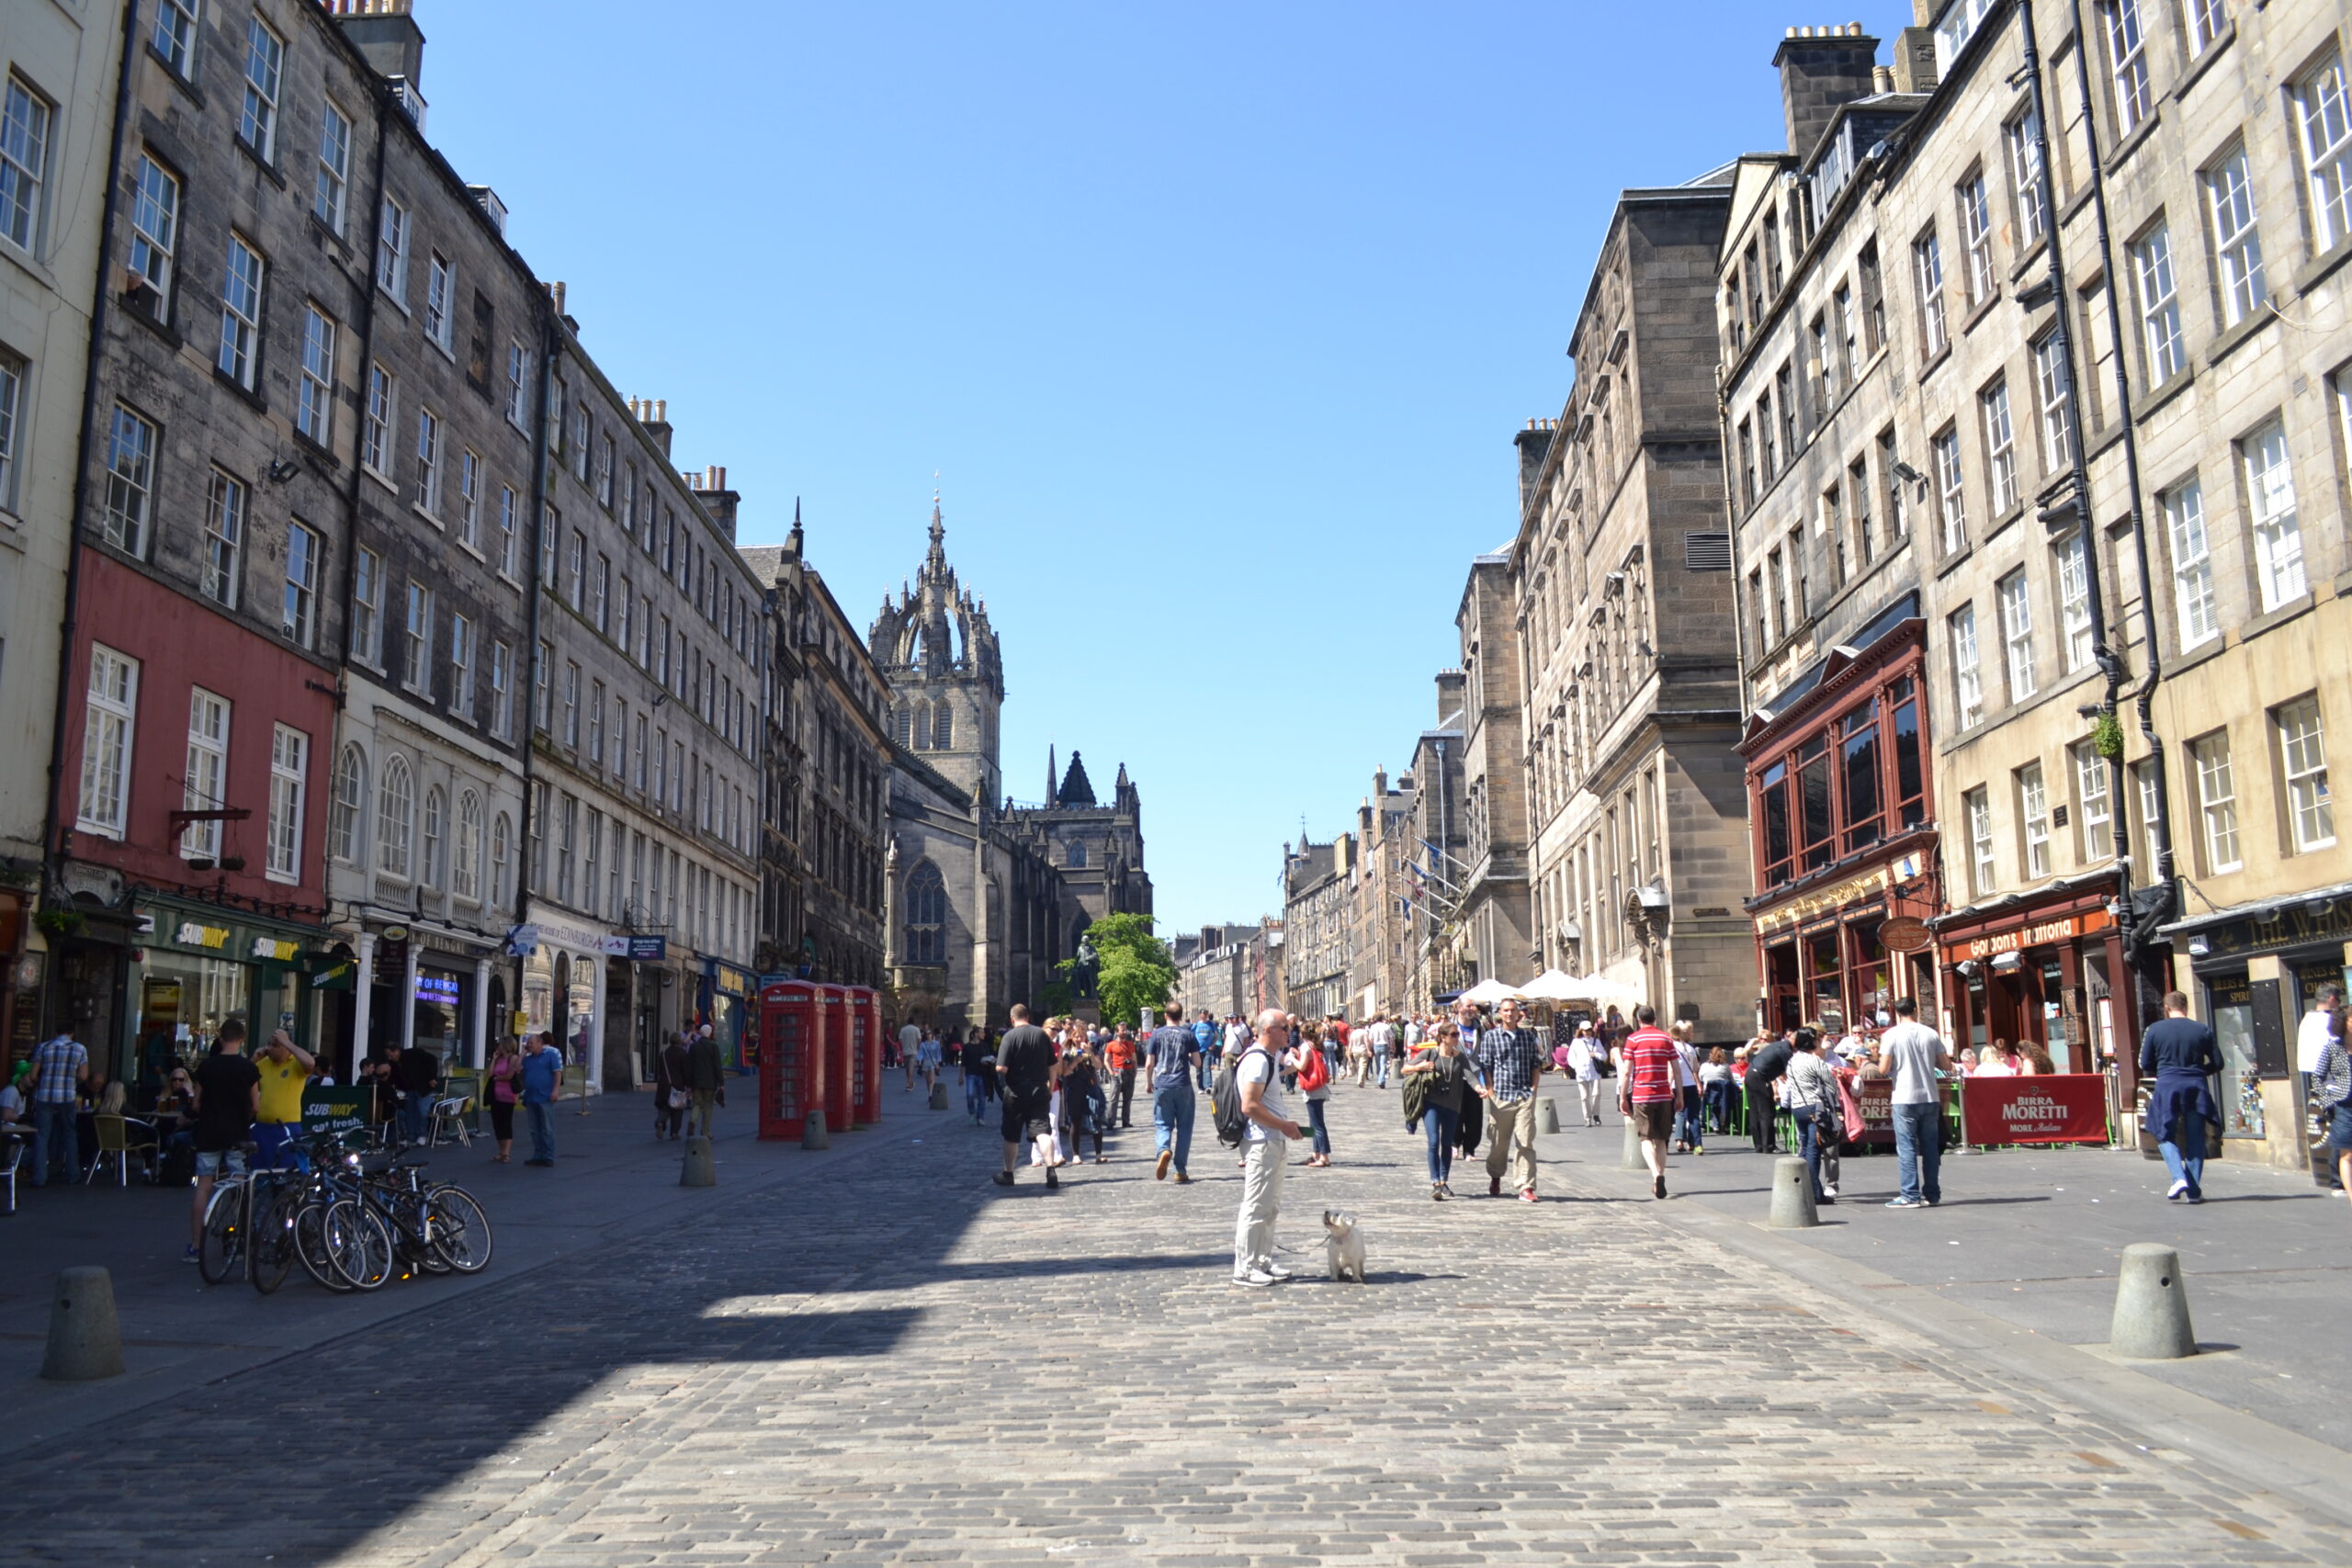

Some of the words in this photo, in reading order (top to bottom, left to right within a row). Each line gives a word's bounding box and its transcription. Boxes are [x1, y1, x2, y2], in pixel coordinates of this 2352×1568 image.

[2245, 913, 2290, 946] THE
[2290, 898, 2352, 938] WHIS
[177, 921, 230, 949] SUBWAY
[420, 932, 431, 947] OF
[435, 936, 466, 955] BENGAL
[560, 925, 594, 948] EDINBURGH
[1971, 930, 2017, 956] Gordon's
[253, 936, 300, 962] SUBWAY
[312, 962, 349, 987] SUBWAY
[435, 979, 458, 993] BENGAL
[2229, 990, 2250, 1003] SPIRI
[305, 1102, 358, 1116] SUBWAY
[2017, 1096, 2055, 1106] BIRRA
[2002, 1103, 2069, 1120] MORETTI
[332, 1116, 364, 1129] fresh.
[2009, 1123, 2033, 1133] MORE
